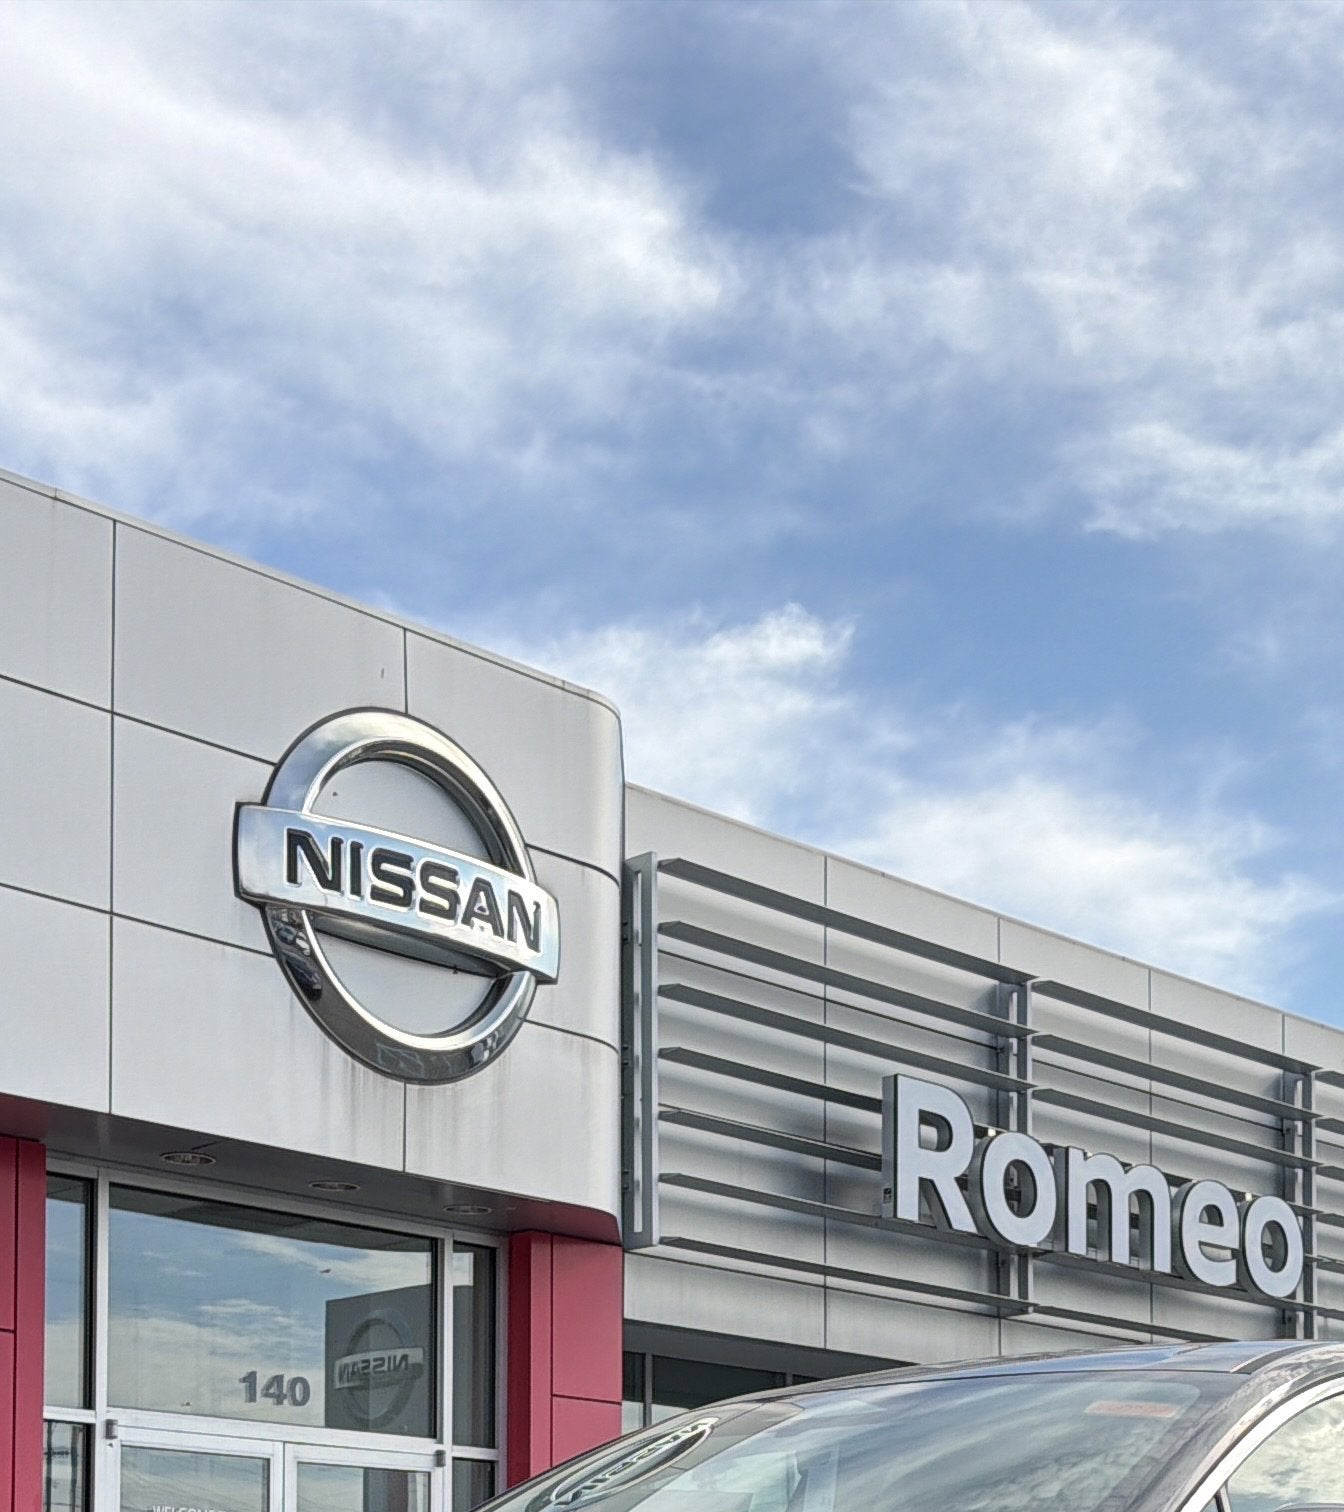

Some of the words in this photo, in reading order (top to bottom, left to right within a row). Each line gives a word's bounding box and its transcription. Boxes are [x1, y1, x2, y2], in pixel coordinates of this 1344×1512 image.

[284, 826, 544, 957] NISSAN
[883, 1074, 1303, 1297] Romeo
[239, 1371, 310, 1406] 140
